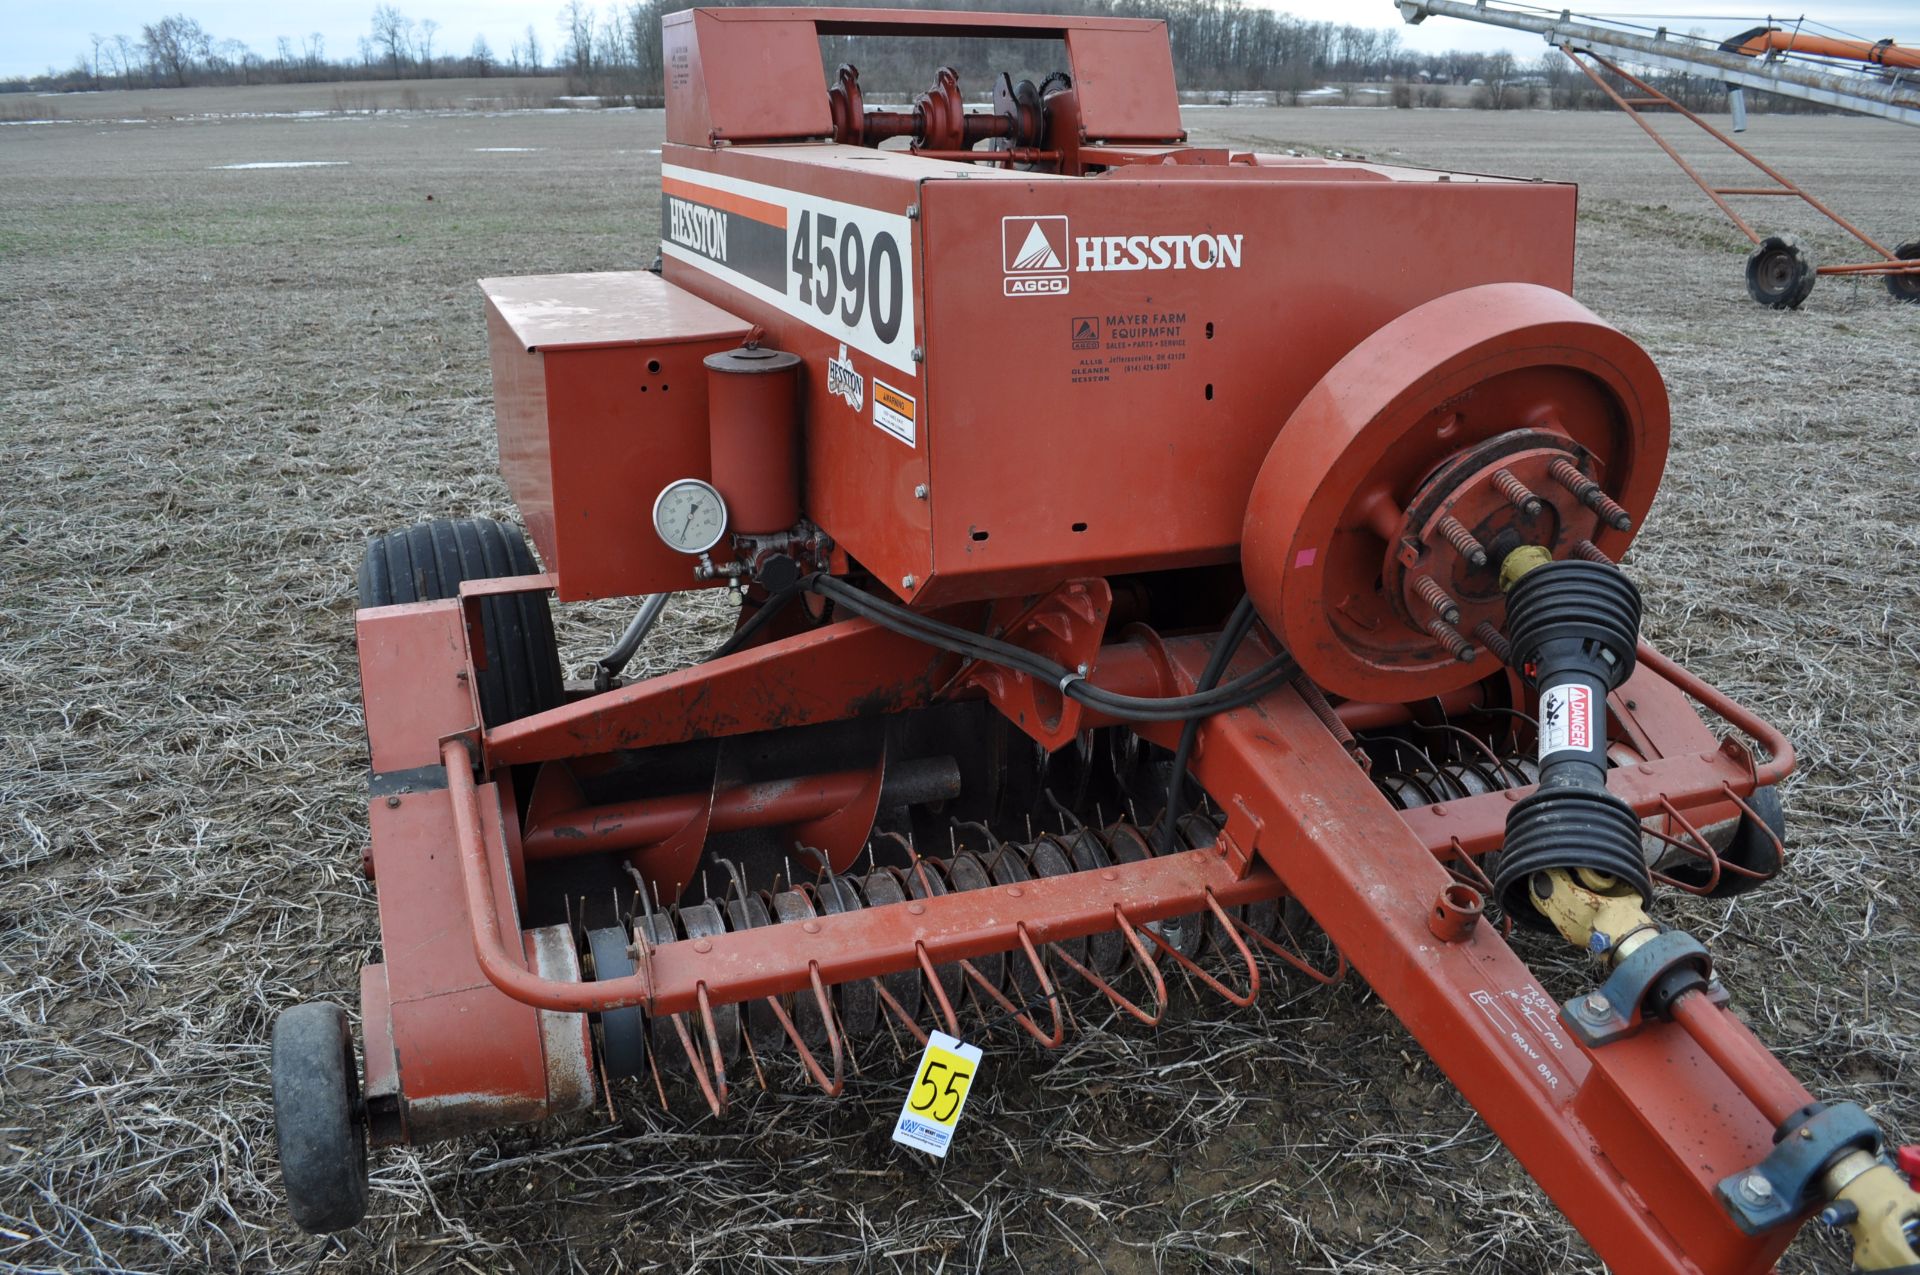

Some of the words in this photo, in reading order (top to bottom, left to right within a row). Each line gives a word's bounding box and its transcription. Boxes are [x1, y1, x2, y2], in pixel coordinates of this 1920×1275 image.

[670, 197, 728, 263] HESSTON
[1076, 234, 1243, 272] HESSTON
[792, 209, 904, 344] 4590
[1012, 280, 1063, 292] AGCO
[1106, 314, 1149, 326] MAYER
[1153, 313, 1186, 324] FARM
[1112, 326, 1182, 339] EQUIPMENT
[1106, 341, 1126, 349] SALES
[1133, 340, 1153, 348] PARTS
[1160, 339, 1186, 347] SERVICE
[829, 360, 862, 396] HESSTON
[886, 394, 905, 411] WARNING
[1571, 702, 1586, 746] DANGER
[1544, 1031, 1563, 1050] PTO
[1511, 1032, 1540, 1059] DRAW
[1537, 1063, 1558, 1089] BAR
[911, 1061, 970, 1122] 55
